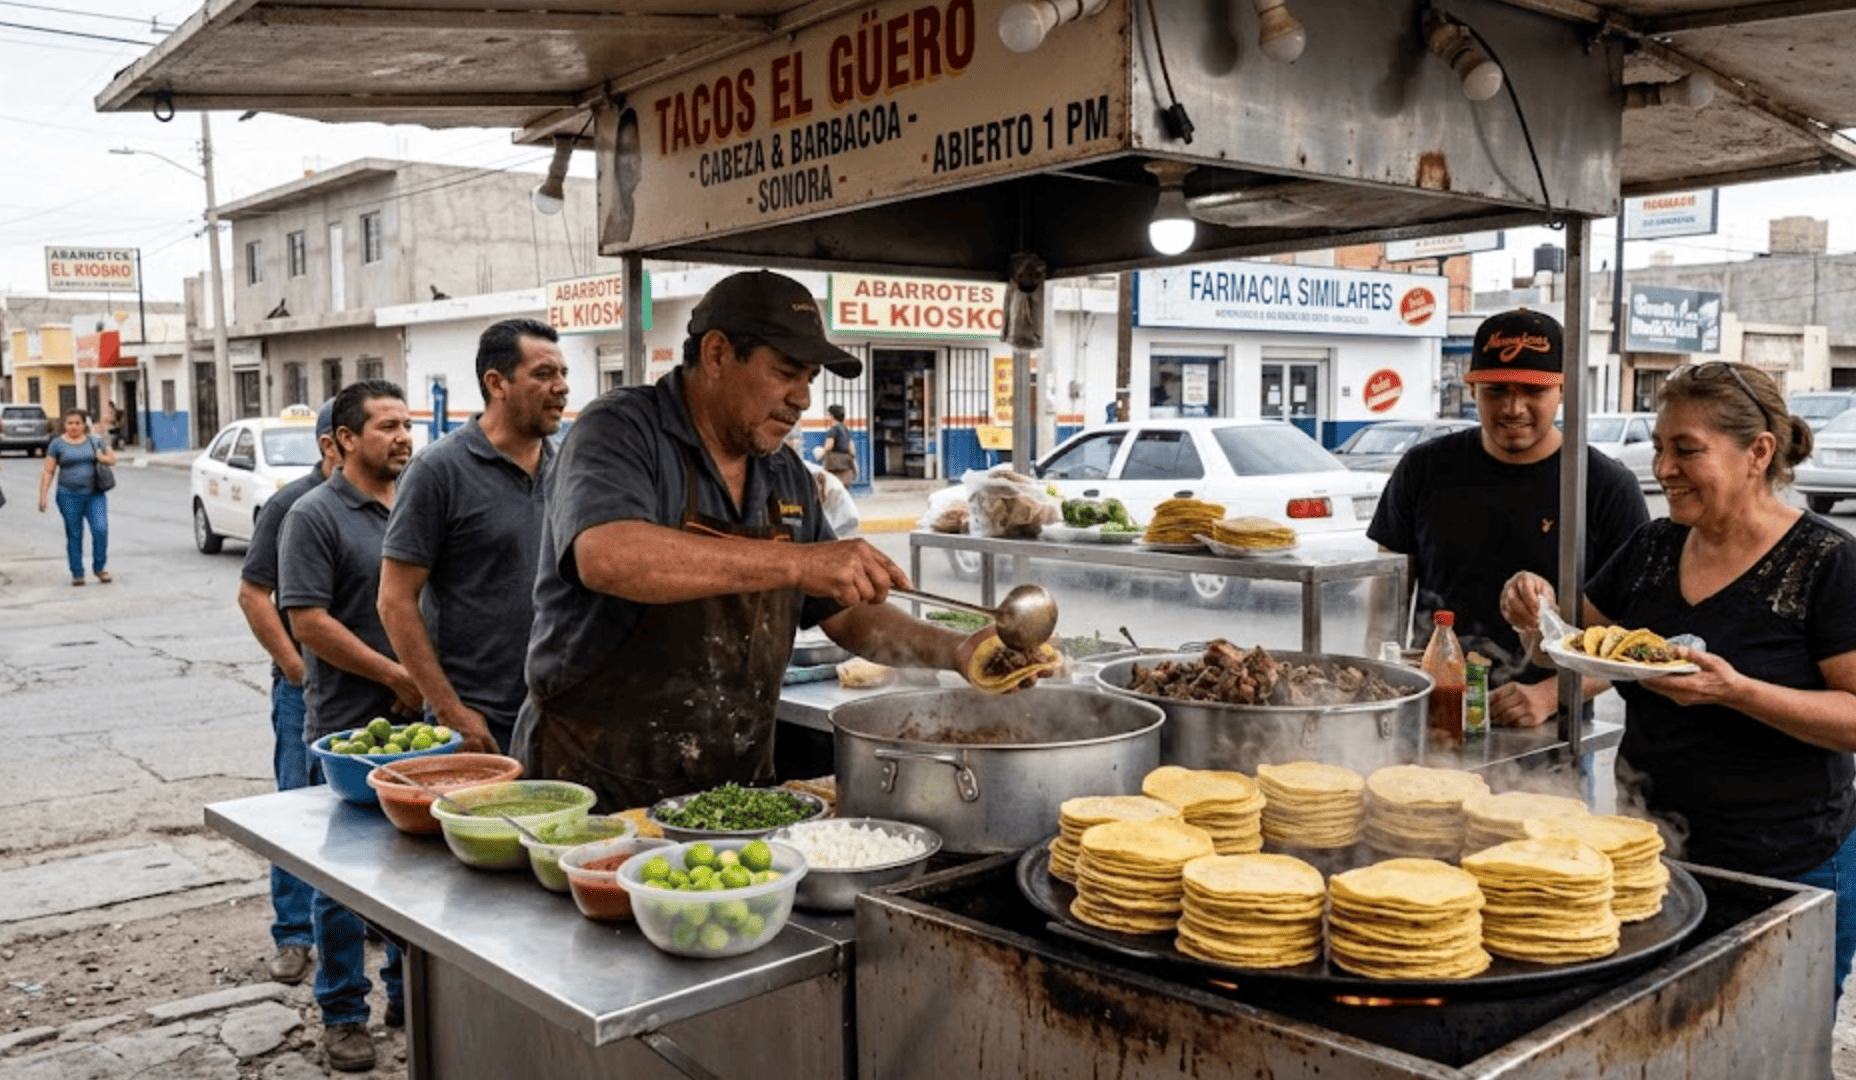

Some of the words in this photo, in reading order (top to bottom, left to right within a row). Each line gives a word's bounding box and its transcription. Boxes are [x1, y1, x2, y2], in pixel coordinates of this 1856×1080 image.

[655, 67, 756, 156] TACOS
[771, 51, 813, 123] EL
[829, 0, 975, 104] GÜERO
[700, 139, 766, 188] CABEZA
[771, 133, 784, 169] &
[791, 101, 902, 164] BARBACOA
[932, 113, 1033, 174] ABIERTO
[1042, 107, 1053, 150] 1
[1067, 95, 1109, 145] PM
[758, 164, 833, 213] SONORA
[51, 262, 69, 277] EL
[854, 280, 994, 303] ABARROTES
[1190, 270, 1292, 306] FARMACIA
[1298, 276, 1393, 311] SIMILARES
[549, 306, 569, 328] EL
[573, 301, 624, 327] KIOSK
[840, 302, 878, 326] EL
